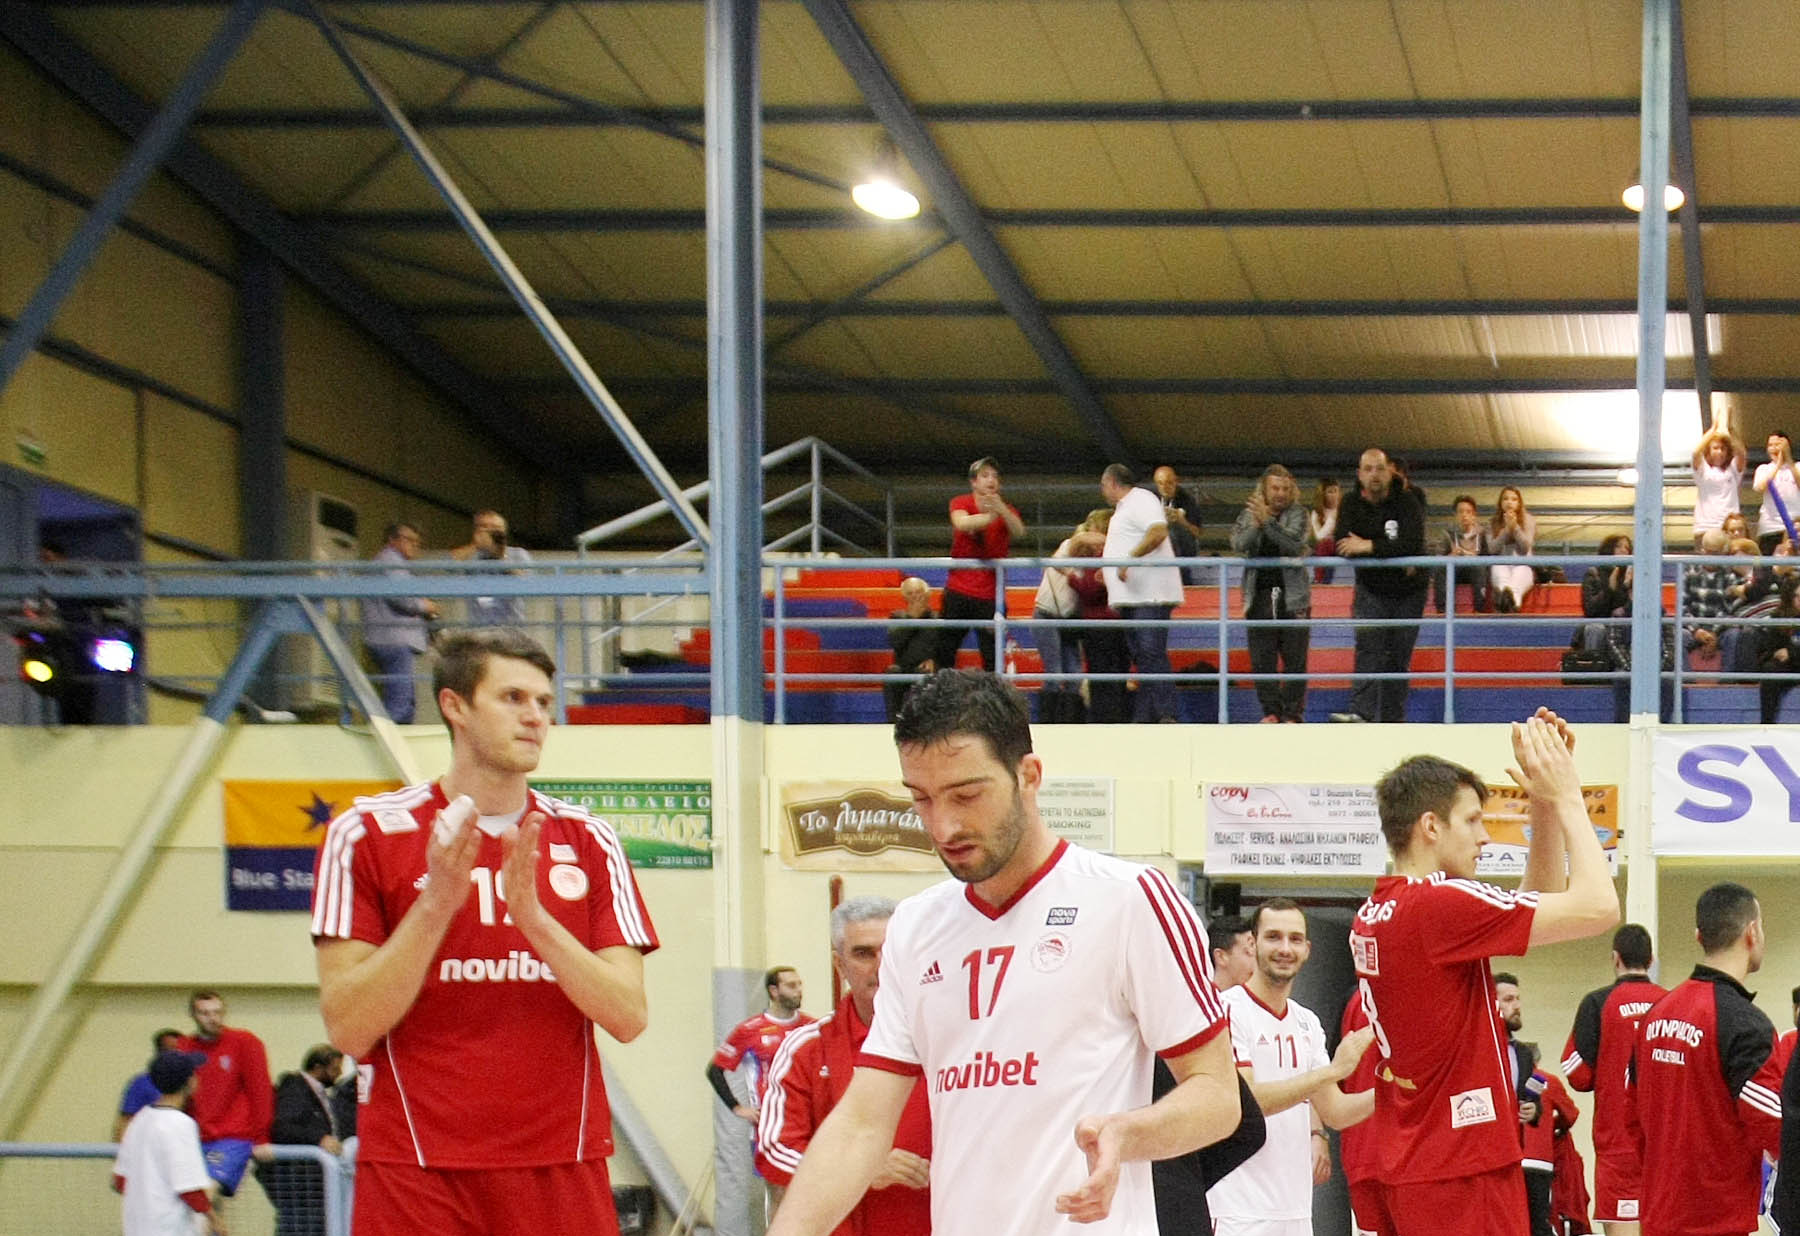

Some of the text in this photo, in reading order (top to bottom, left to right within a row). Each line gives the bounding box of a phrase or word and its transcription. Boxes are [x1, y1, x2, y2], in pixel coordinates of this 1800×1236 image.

[563, 796, 711, 808] ΡΟΠΩΛΕΙΟ
[833, 801, 925, 833] λιμανάκ
[232, 867, 314, 889] Blue Sta
[439, 950, 559, 983] novibe
[961, 945, 1016, 1020] 17
[1274, 1033, 1298, 1069] 11
[935, 1050, 1041, 1095] novibet
